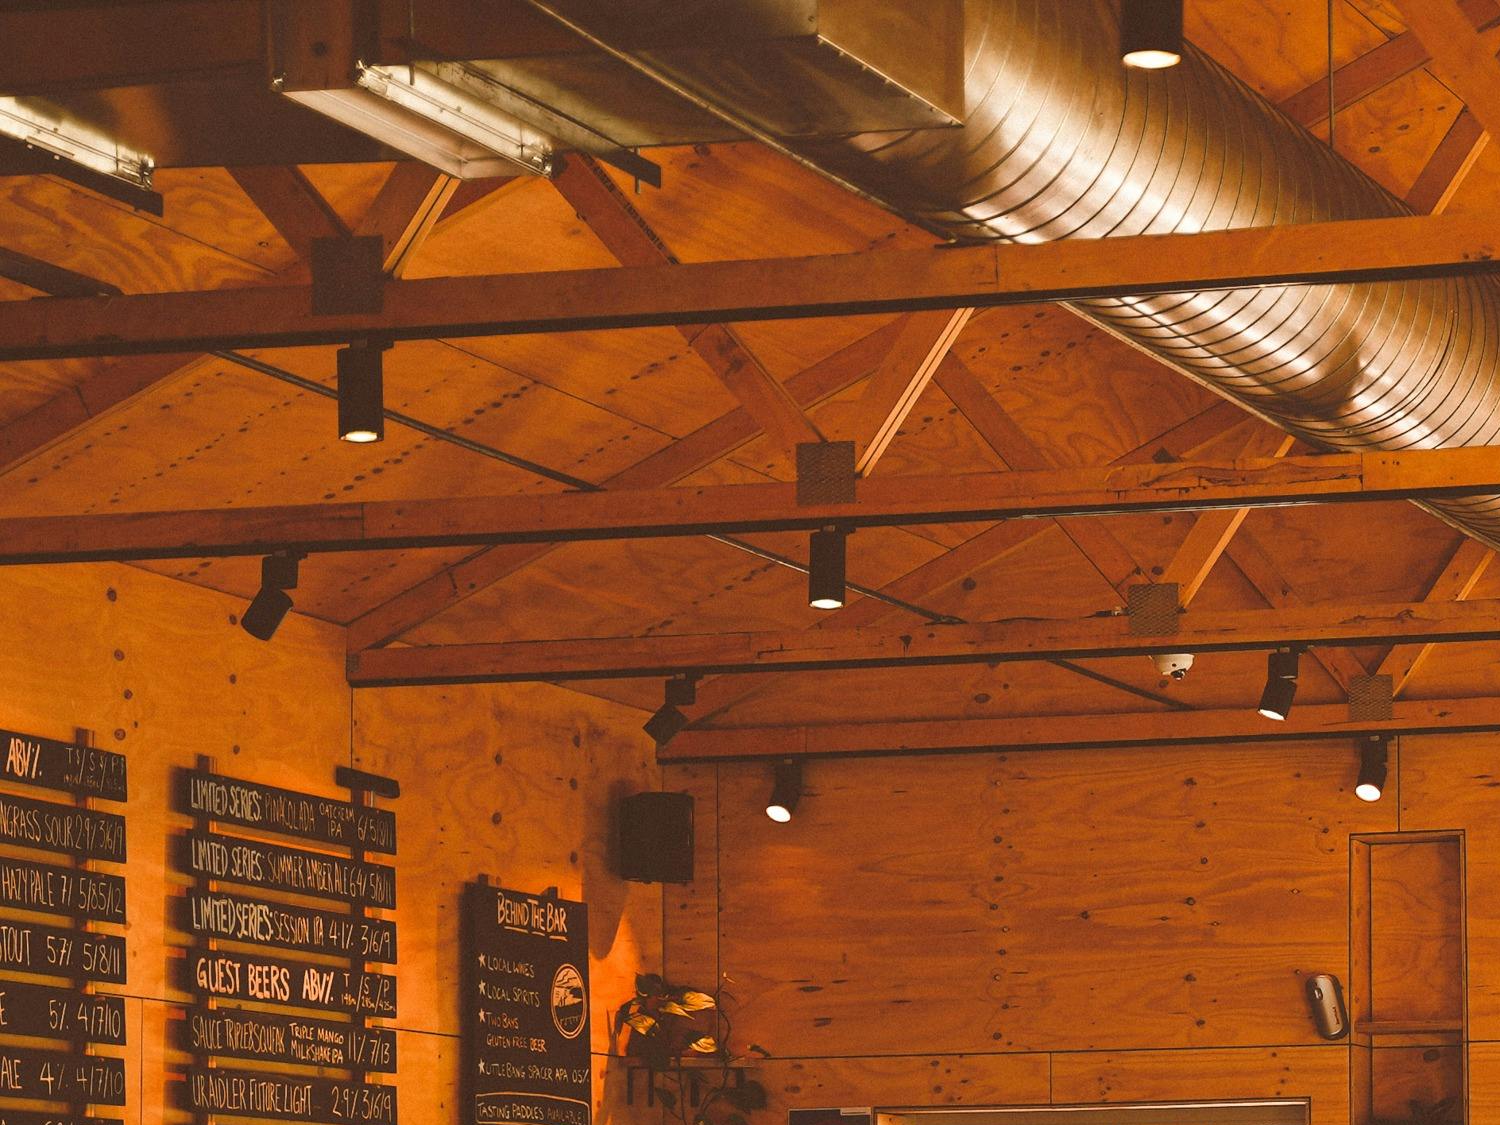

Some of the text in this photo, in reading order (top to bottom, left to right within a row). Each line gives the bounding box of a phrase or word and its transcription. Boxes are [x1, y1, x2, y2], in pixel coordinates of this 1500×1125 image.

[45, 814, 73, 848] SOUR
[192, 838, 228, 878] LIMITED
[2, 864, 28, 904] HAZY
[30, 869, 55, 907] PALE
[273, 910, 309, 945] SESSION
[527, 899, 546, 932] THE
[546, 902, 568, 934] BAR
[0, 926, 31, 967] TOUT
[196, 957, 241, 995] GUEST
[248, 963, 290, 1002] BEERS
[487, 955, 512, 974] LOCAL
[487, 983, 541, 1007] LOCAL SPIRITS
[192, 1015, 222, 1051] SAUCE
[289, 1022, 314, 1040] TRIPLE
[318, 1028, 344, 1045] MANGO
[486, 1035, 511, 1048] GLUTEN
[512, 1036, 528, 1049] FREE
[0, 1056, 22, 1090] ALE
[284, 1084, 312, 1116] LIGHT
[477, 1102, 510, 1120] TASTING
[511, 1103, 545, 1120] PADDLES
